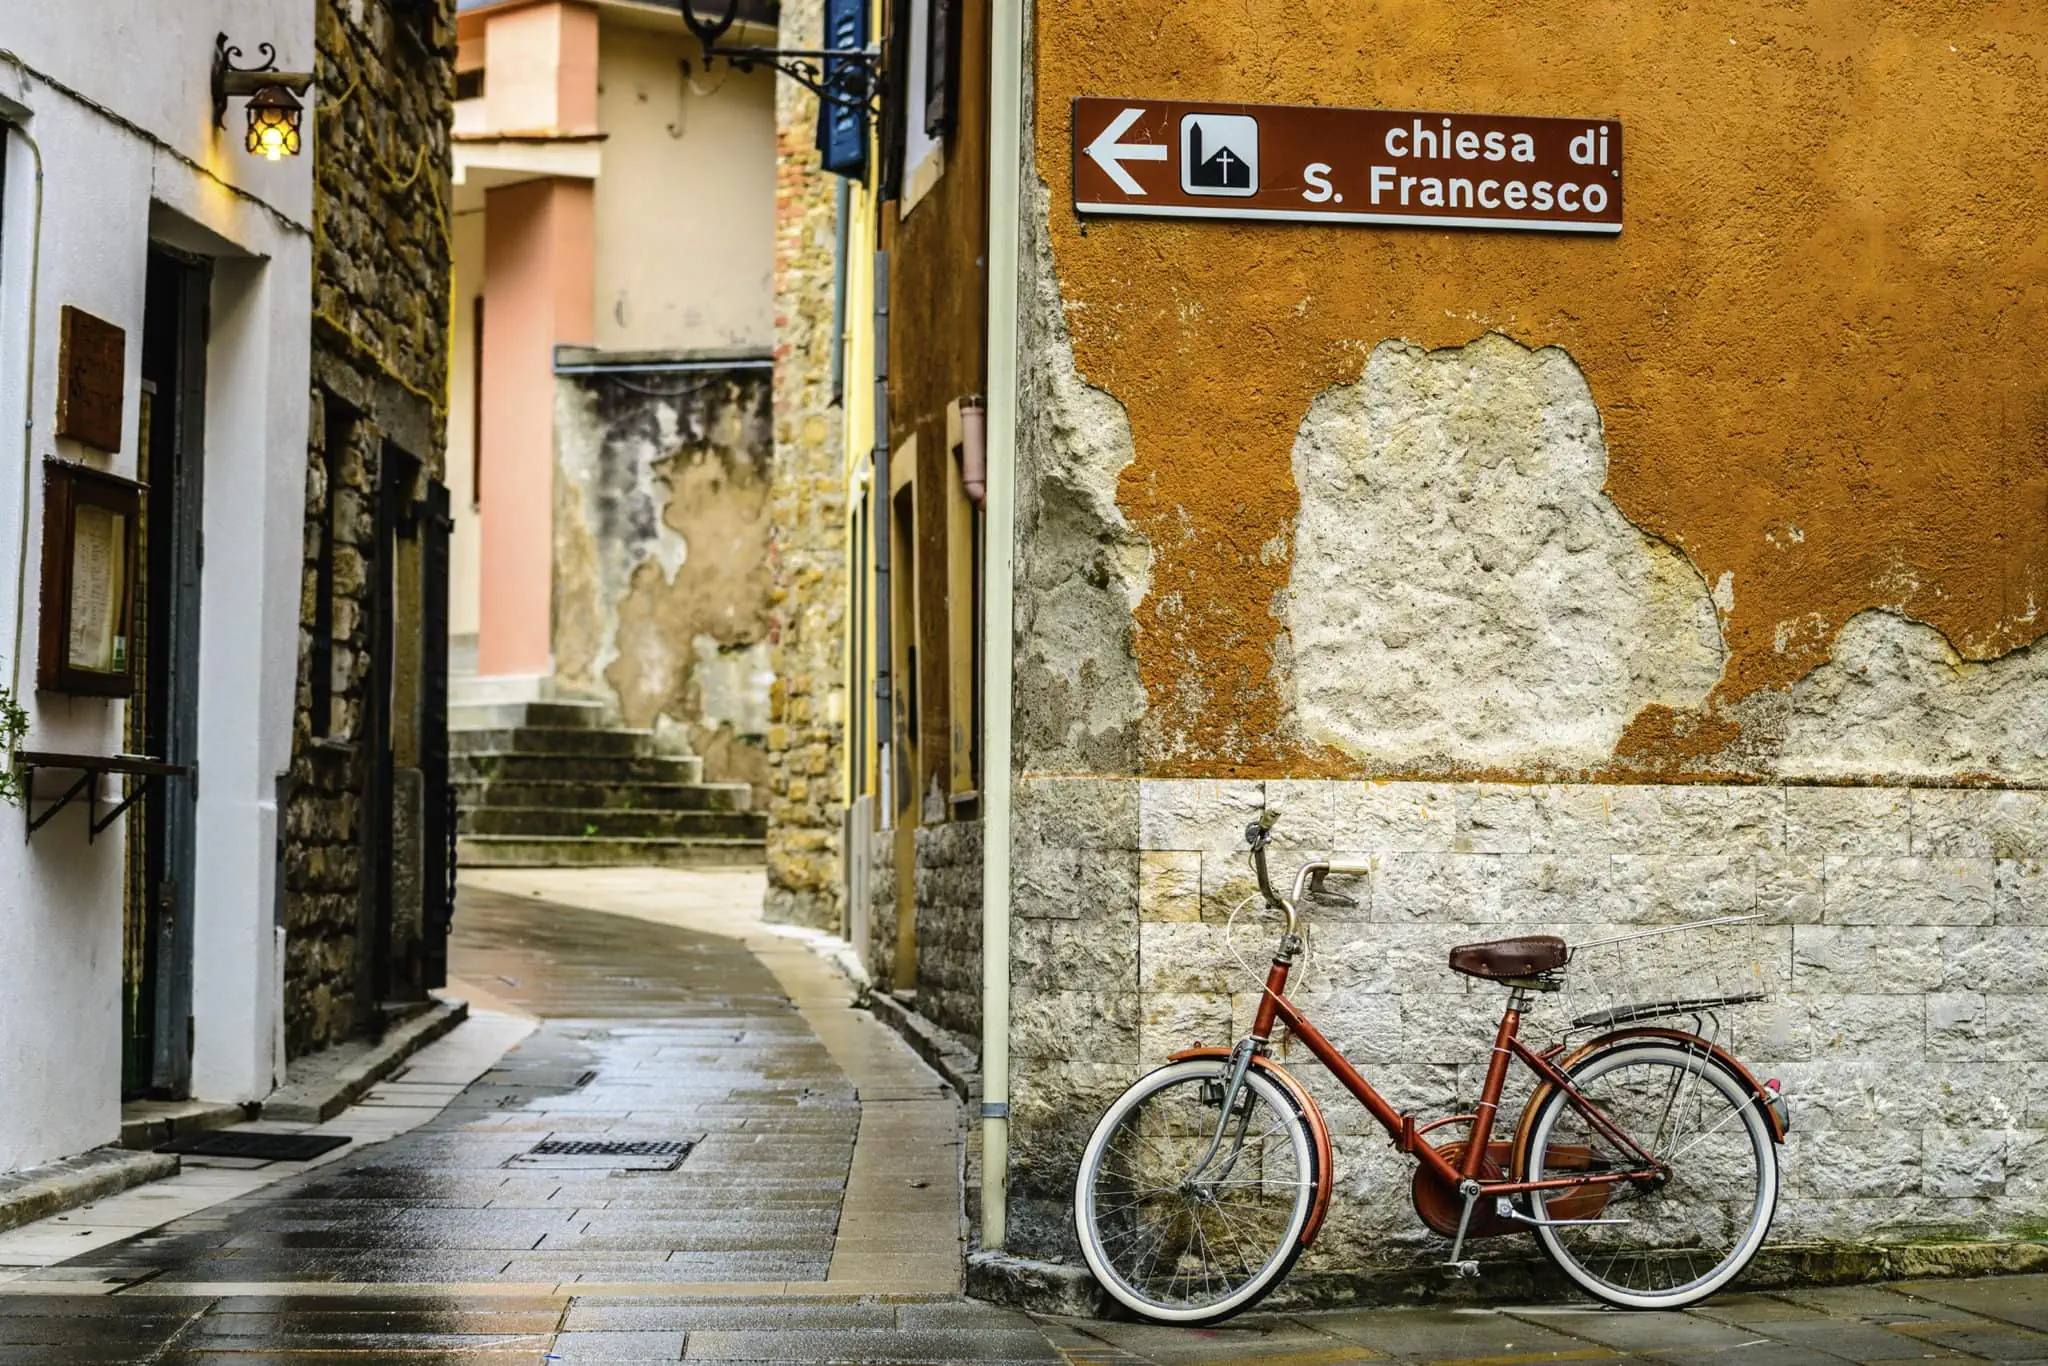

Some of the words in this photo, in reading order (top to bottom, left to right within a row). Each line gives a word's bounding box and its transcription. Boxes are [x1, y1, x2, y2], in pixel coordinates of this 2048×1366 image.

[1385, 119, 1536, 163] chiesa
[1569, 126, 1608, 165] di
[1303, 163, 1344, 203] S.
[1371, 166, 1608, 213] Francesco
